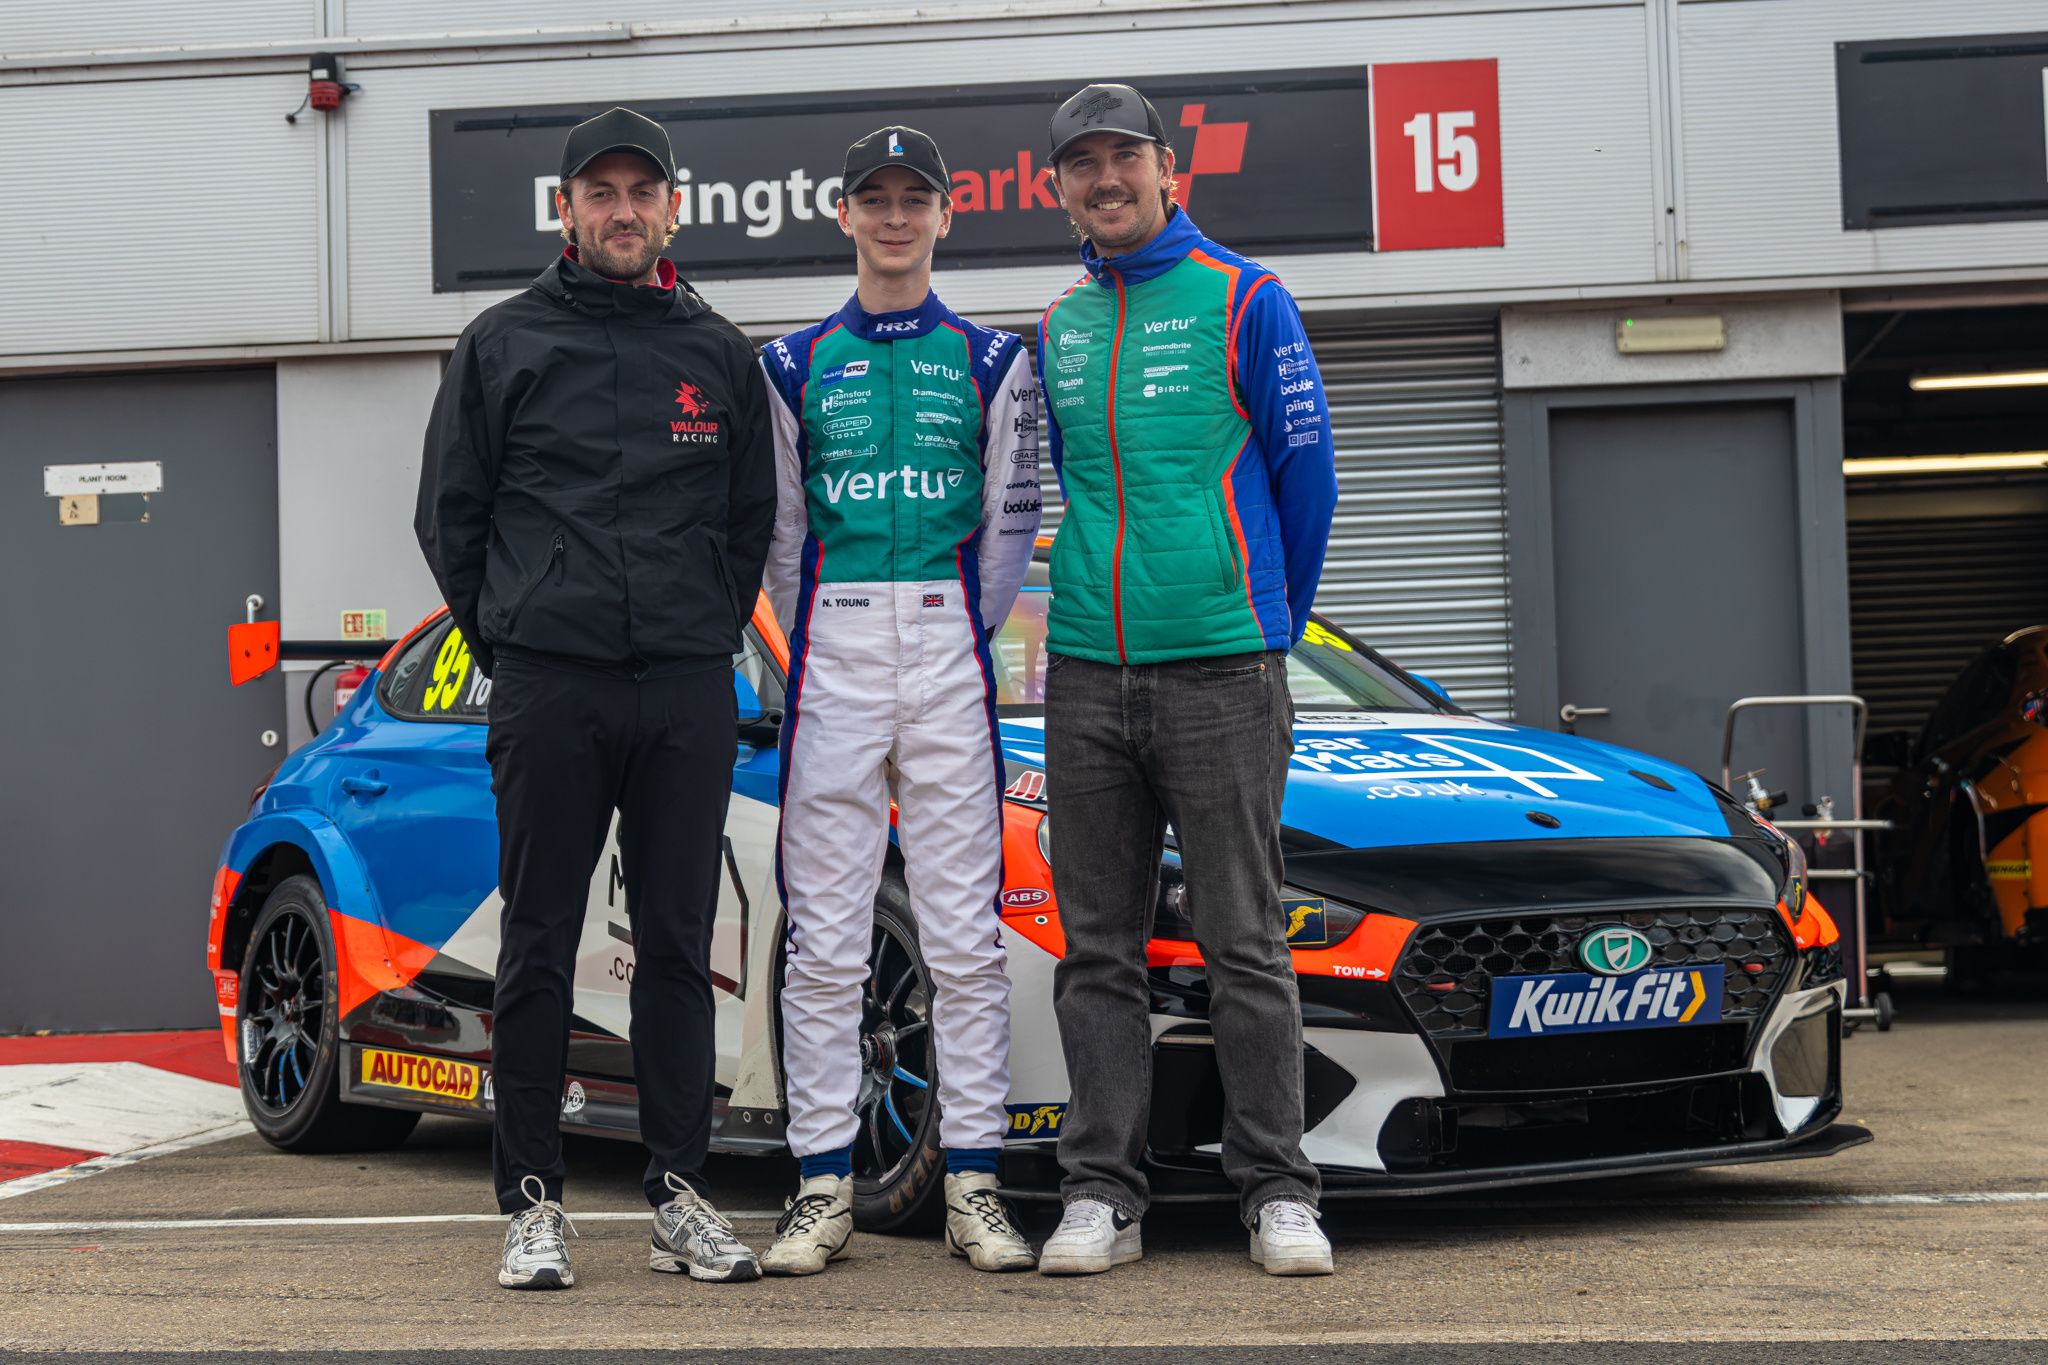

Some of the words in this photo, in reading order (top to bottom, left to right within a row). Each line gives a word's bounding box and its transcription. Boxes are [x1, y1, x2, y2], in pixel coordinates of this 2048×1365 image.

[1403, 110, 1480, 193] 15
[534, 168, 844, 238] Dingto
[950, 151, 1059, 212] ark
[876, 319, 919, 333] HRX
[982, 332, 1009, 368] HRX
[1142, 342, 1192, 353] Diamondbrite
[1060, 356, 1085, 367] DRAPER
[845, 364, 867, 374] BTCC
[834, 389, 872, 400] Hansford
[1157, 385, 1190, 393] BIRCH
[1010, 388, 1038, 403] Vert
[832, 398, 868, 408] Sensors
[826, 418, 868, 431] DRAPER
[1293, 415, 1322, 426] OCTANE
[670, 421, 719, 433] VALOUR
[672, 433, 718, 444] RACING
[830, 430, 864, 441] TOOLS
[822, 598, 833, 607] N.
[836, 598, 870, 607] YOUNG
[1007, 891, 1043, 903] ABS
[1333, 965, 1365, 977] TOW
[370, 1052, 474, 1097] AUTOCAR
